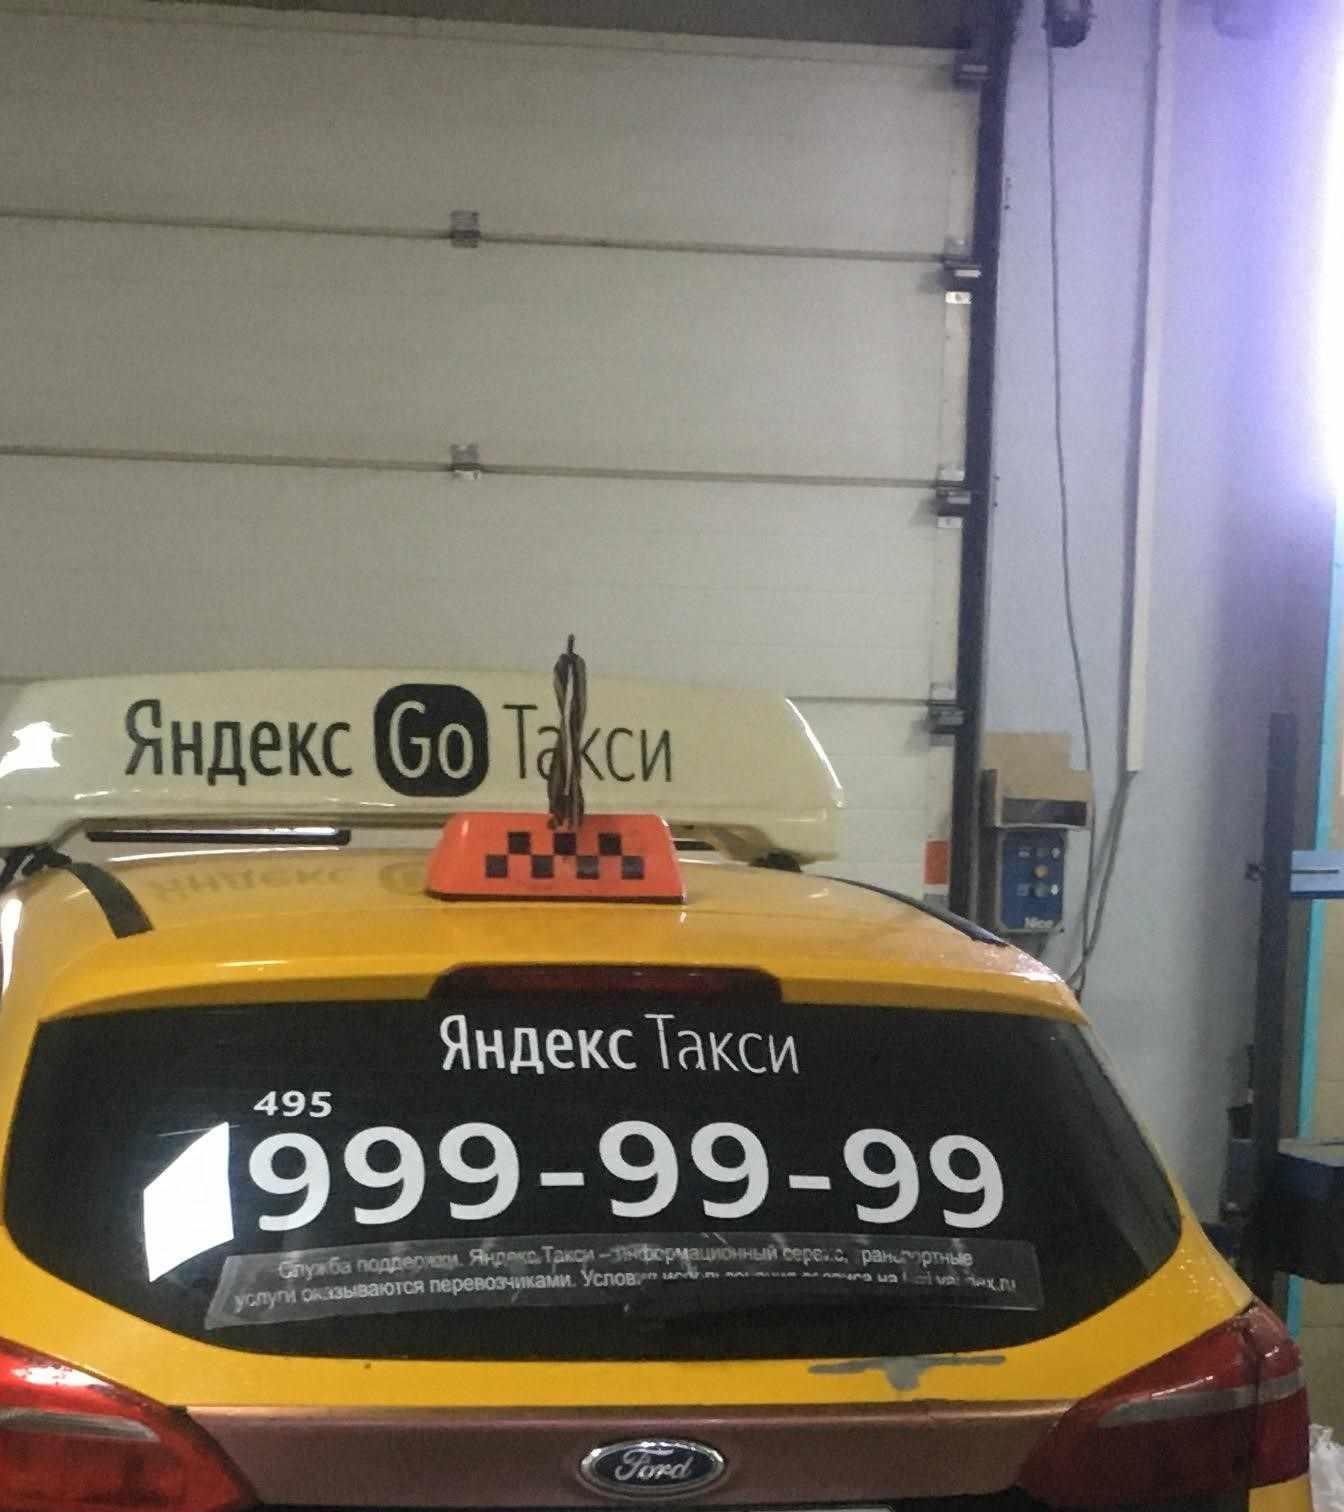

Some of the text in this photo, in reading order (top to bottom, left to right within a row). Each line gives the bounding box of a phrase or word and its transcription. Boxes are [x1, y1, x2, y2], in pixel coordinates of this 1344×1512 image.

[124, 699, 673, 787] Яндекс Go Такси
[439, 1013, 800, 1075] Яндекс Такси
[253, 1090, 334, 1119] 495
[247, 1120, 1006, 1232] 999-99-99
[278, 1256, 352, 1281] Служба
[234, 1289, 297, 1314] услуги
[615, 1448, 694, 1481] Ford
